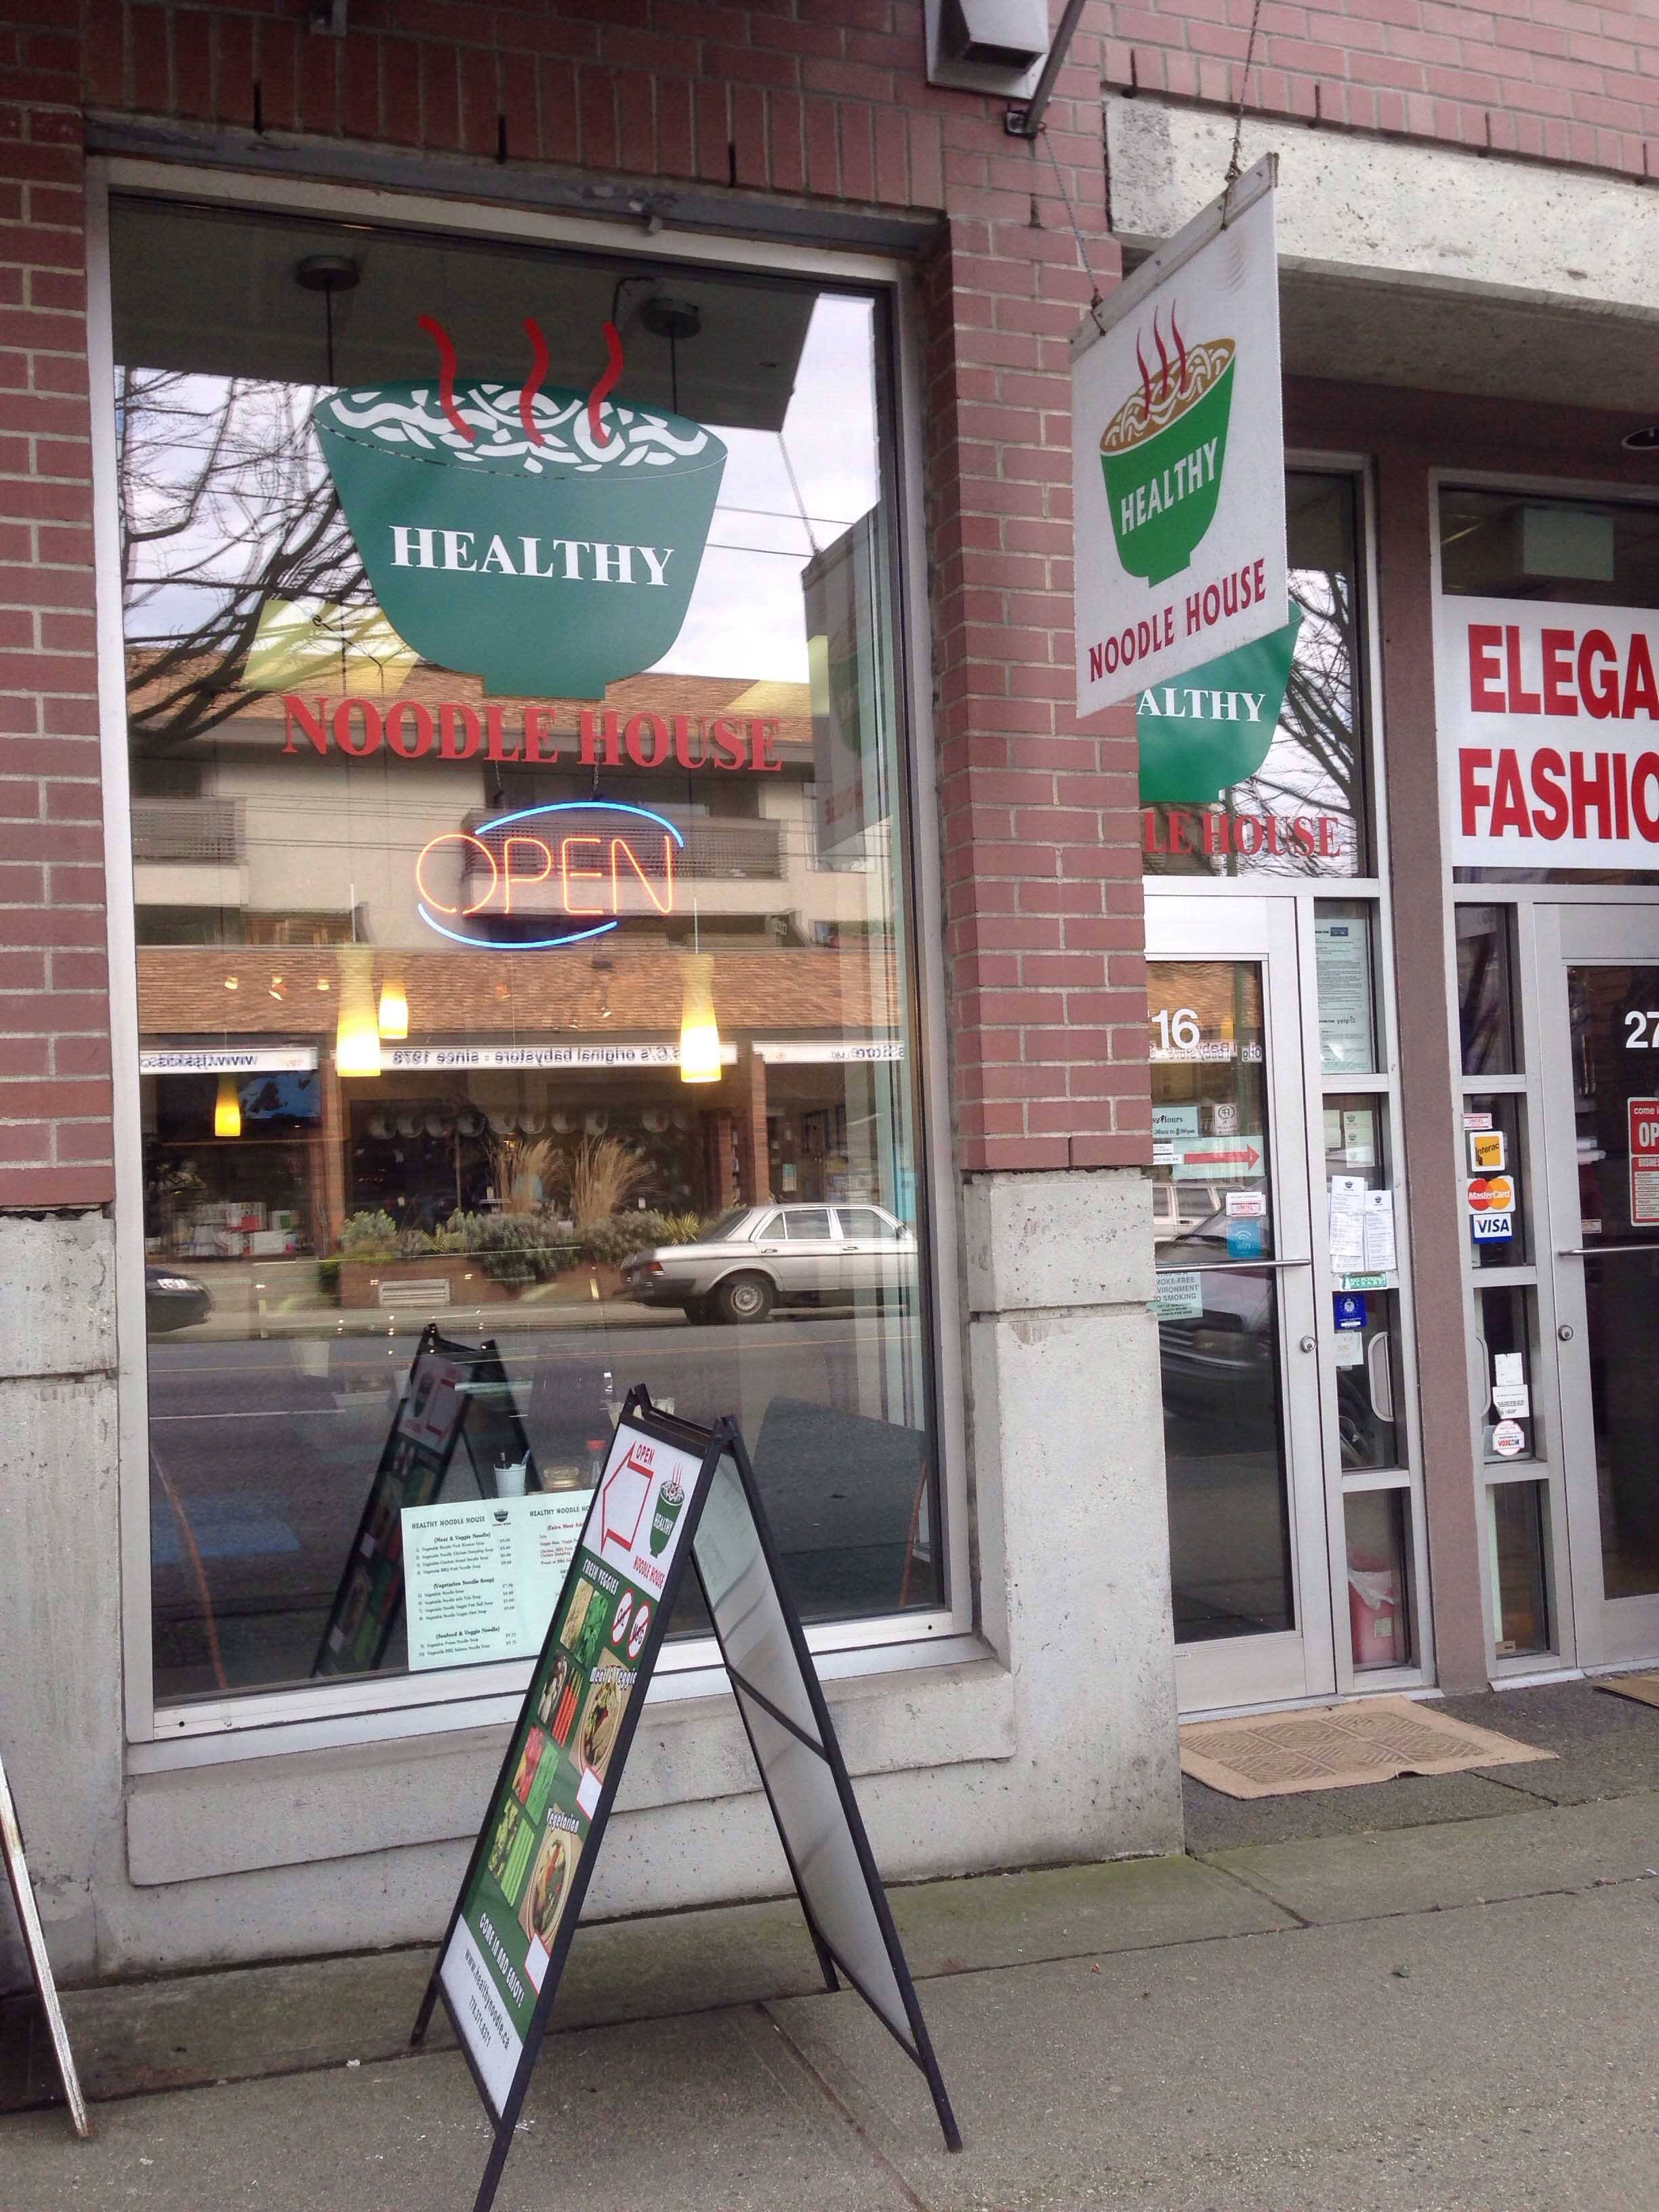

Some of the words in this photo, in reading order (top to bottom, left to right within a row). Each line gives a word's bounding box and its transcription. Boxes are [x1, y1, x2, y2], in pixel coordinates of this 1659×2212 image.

[1120, 436, 1218, 537] HEALTHY
[388, 525, 675, 587] HEALTHY
[1088, 607, 1176, 683] NOODLE
[1185, 557, 1267, 636] HOUSE
[282, 694, 560, 764] NOODLE
[575, 708, 784, 772] HOUSE
[1202, 813, 1341, 857] HOUSE
[415, 833, 674, 915] OPEN
[1633, 1107, 1655, 1115] come
[1469, 1189, 1511, 1202] MasterCard
[1475, 1218, 1510, 1233] VISA
[1163, 1293, 1196, 1302] SMOKING
[636, 1443, 655, 1466] OPEN
[411, 1520, 438, 1530] HEALTHY
[439, 1518, 464, 1527] NOODLE
[466, 1515, 486, 1524] HOUSE
[529, 1509, 554, 1517] HEALTHY
[556, 1507, 580, 1515] NOODLE
[653, 1512, 675, 1536] HEALTHY
[582, 1557, 599, 1580] FRESH
[597, 1568, 620, 1596] VEGGIES
[633, 1555, 651, 1578] NOODLE
[649, 1565, 667, 1590] HOUSE
[615, 1667, 638, 1691] Veggie
[545, 1806, 581, 1835] Vegetarian
[479, 1911, 495, 1947] COME
[491, 1935, 501, 1958] IN
[496, 1946, 510, 1976] AND
[506, 1965, 526, 2009] ENJOY!
